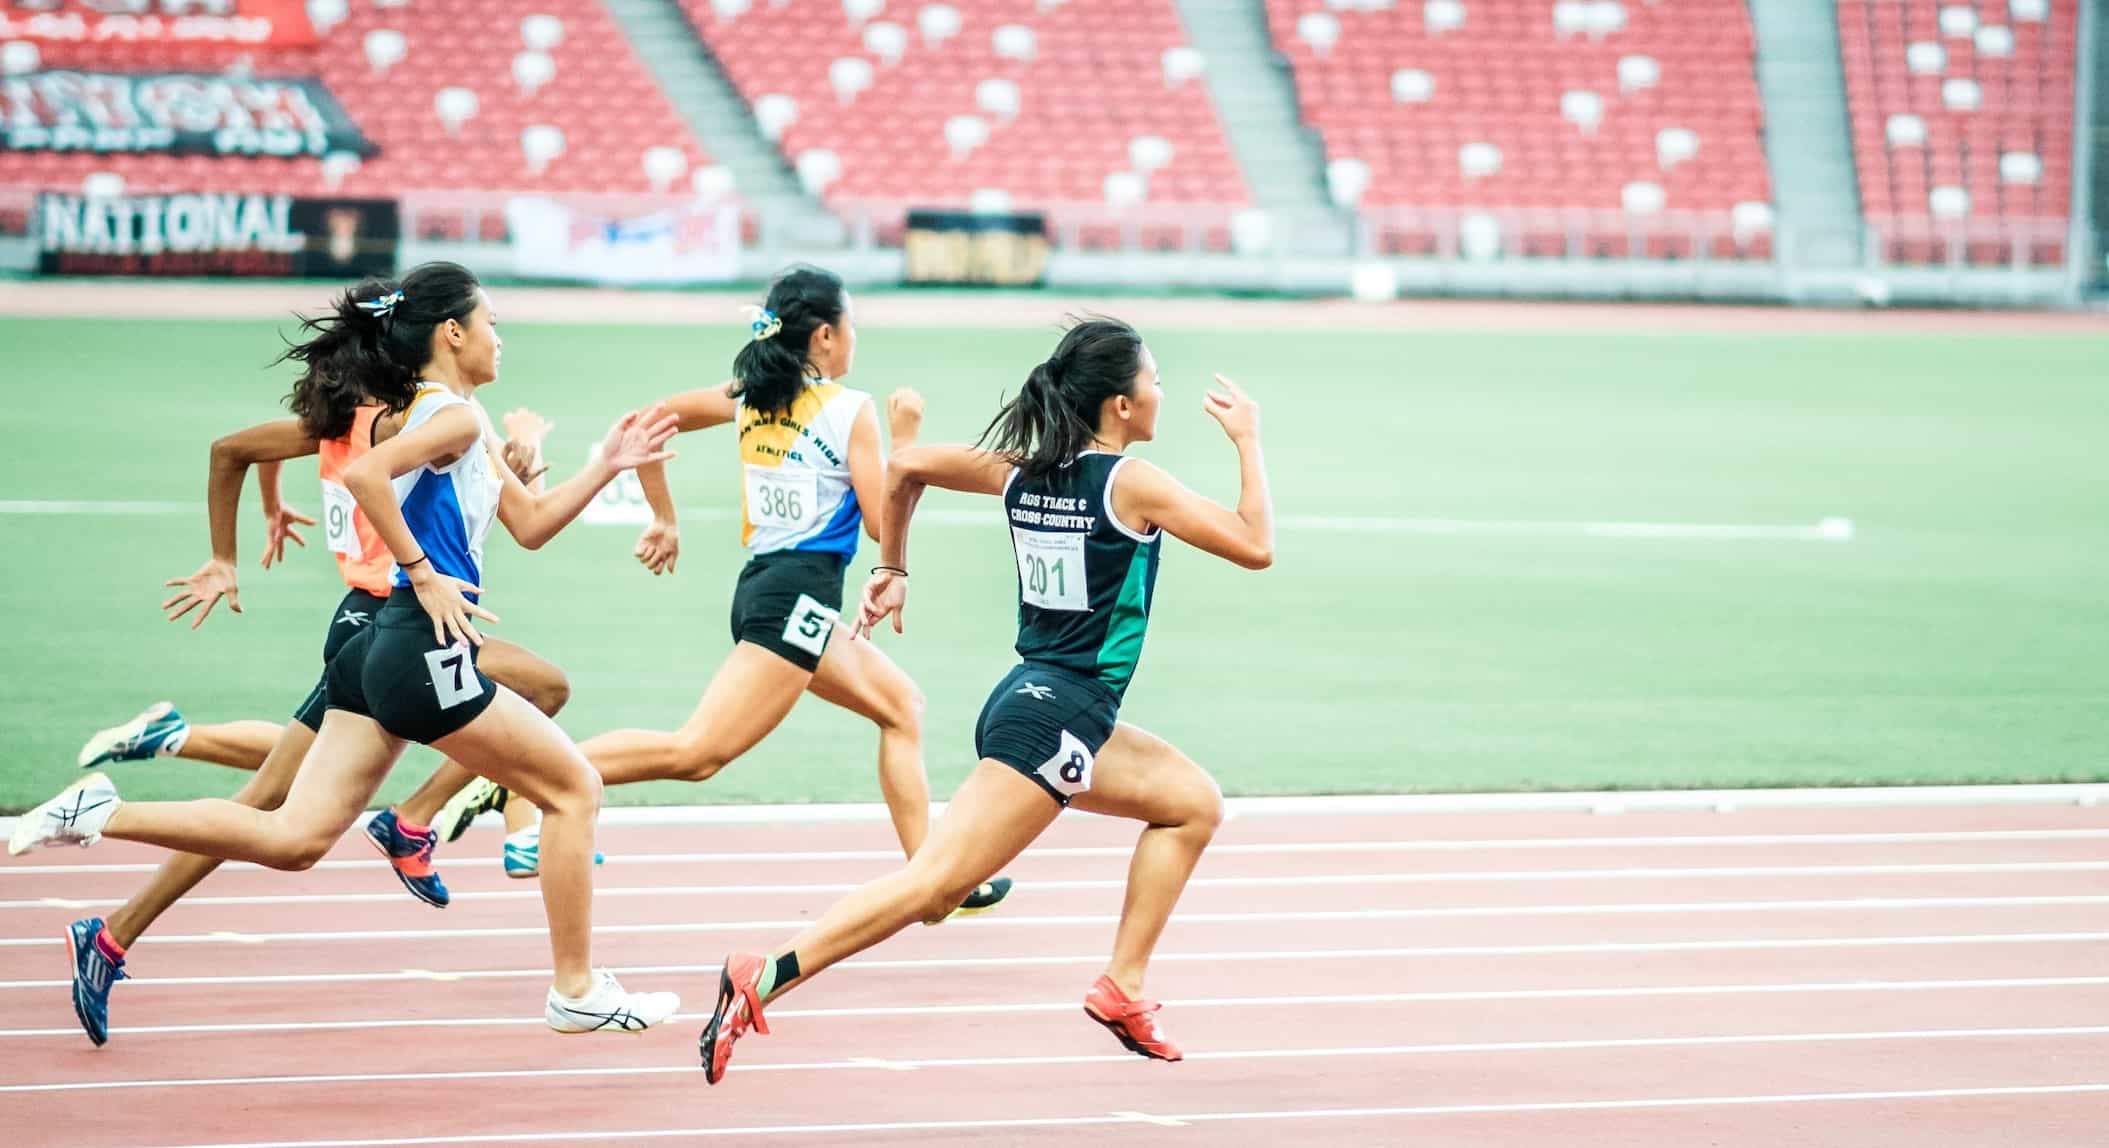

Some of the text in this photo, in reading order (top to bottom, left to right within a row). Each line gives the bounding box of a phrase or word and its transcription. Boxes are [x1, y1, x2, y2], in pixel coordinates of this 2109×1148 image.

[43, 194, 305, 254] NATIONAL
[755, 444, 803, 463] ATHLETICS
[813, 436, 842, 467] HIGH
[759, 484, 803, 522] 386
[1018, 492, 1041, 507] RGS
[1042, 495, 1077, 511] TRACK
[1010, 507, 1096, 530] CROSS-COUNTRY
[1025, 552, 1065, 597] 201
[798, 608, 825, 638] 5
[440, 653, 464, 692] 7
[1059, 750, 1085, 783] 8
